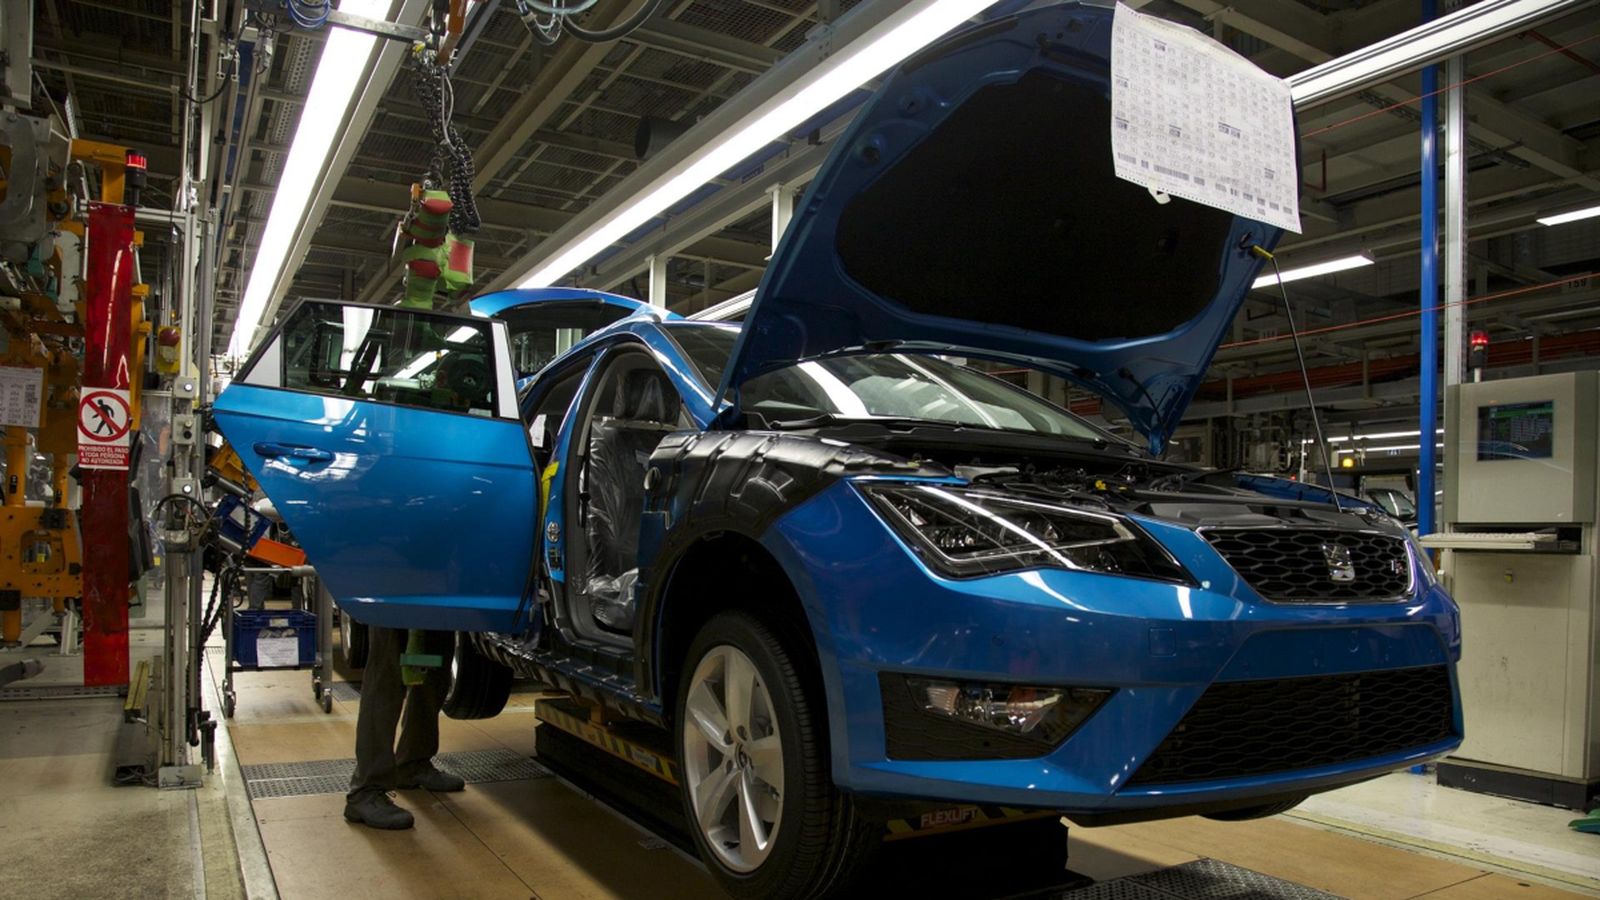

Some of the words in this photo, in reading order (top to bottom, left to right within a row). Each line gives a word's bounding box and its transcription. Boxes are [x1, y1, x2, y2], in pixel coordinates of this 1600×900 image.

[78, 445, 105, 453] PROHIBIDO
[106, 446, 113, 454] EL
[90, 457, 125, 465] AUTORIZADA
[920, 808, 976, 828] FLEXLIFT
